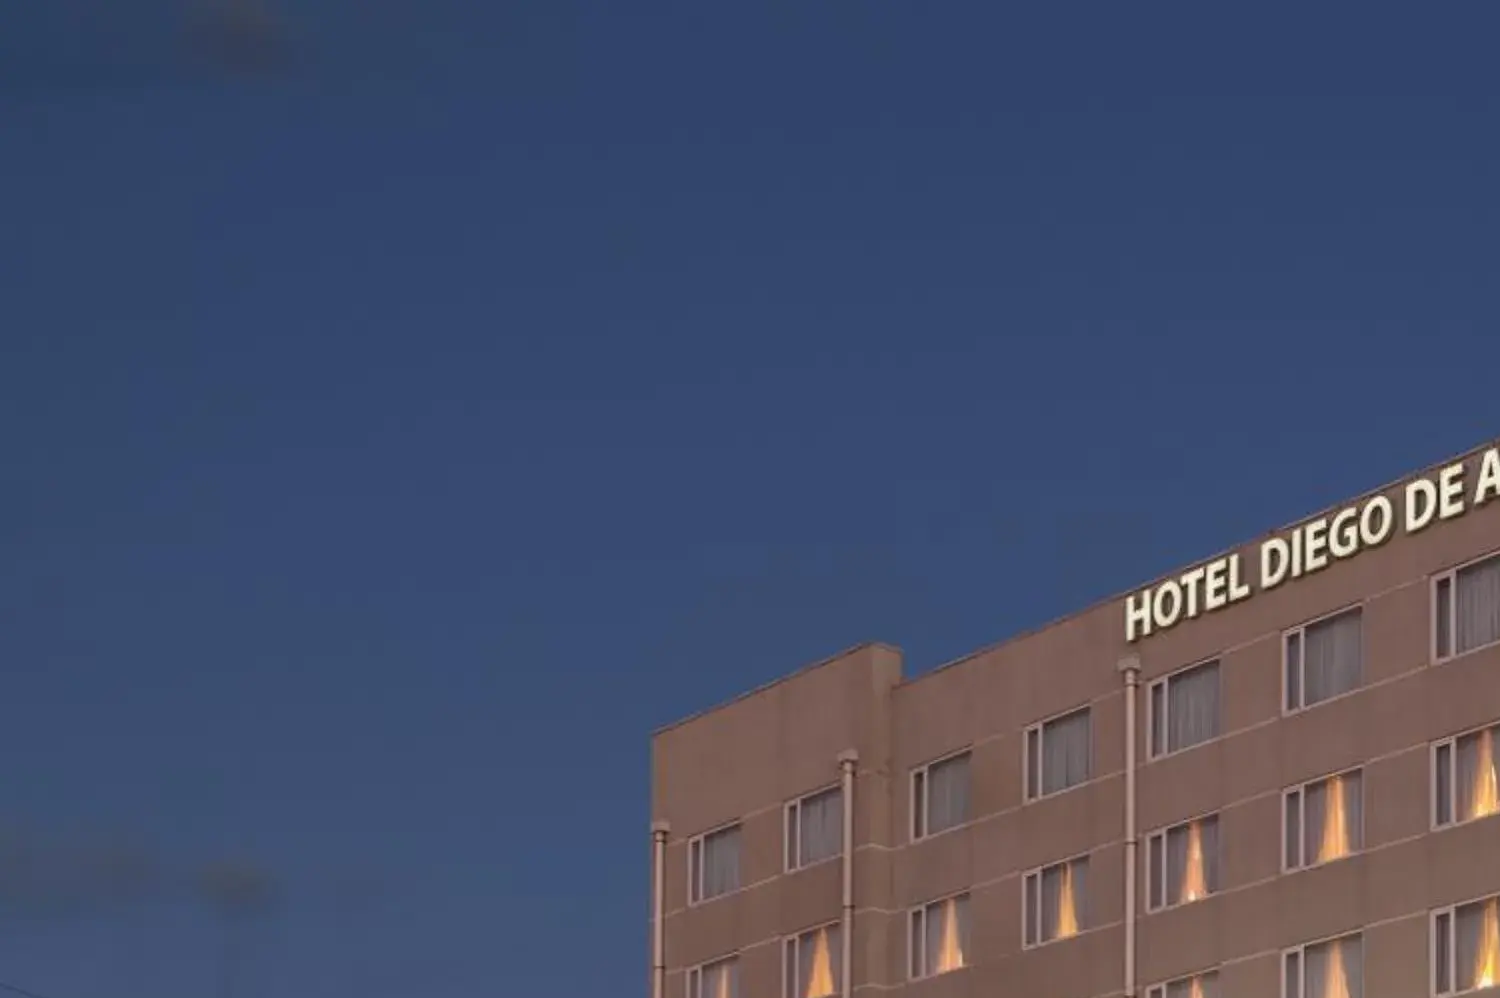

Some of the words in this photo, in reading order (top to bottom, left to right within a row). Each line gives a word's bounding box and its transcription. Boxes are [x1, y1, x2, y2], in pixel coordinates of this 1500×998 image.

[1124, 552, 1249, 642] HOTEL
[1259, 494, 1393, 589] DIEGO
[1404, 461, 1467, 533] DE
